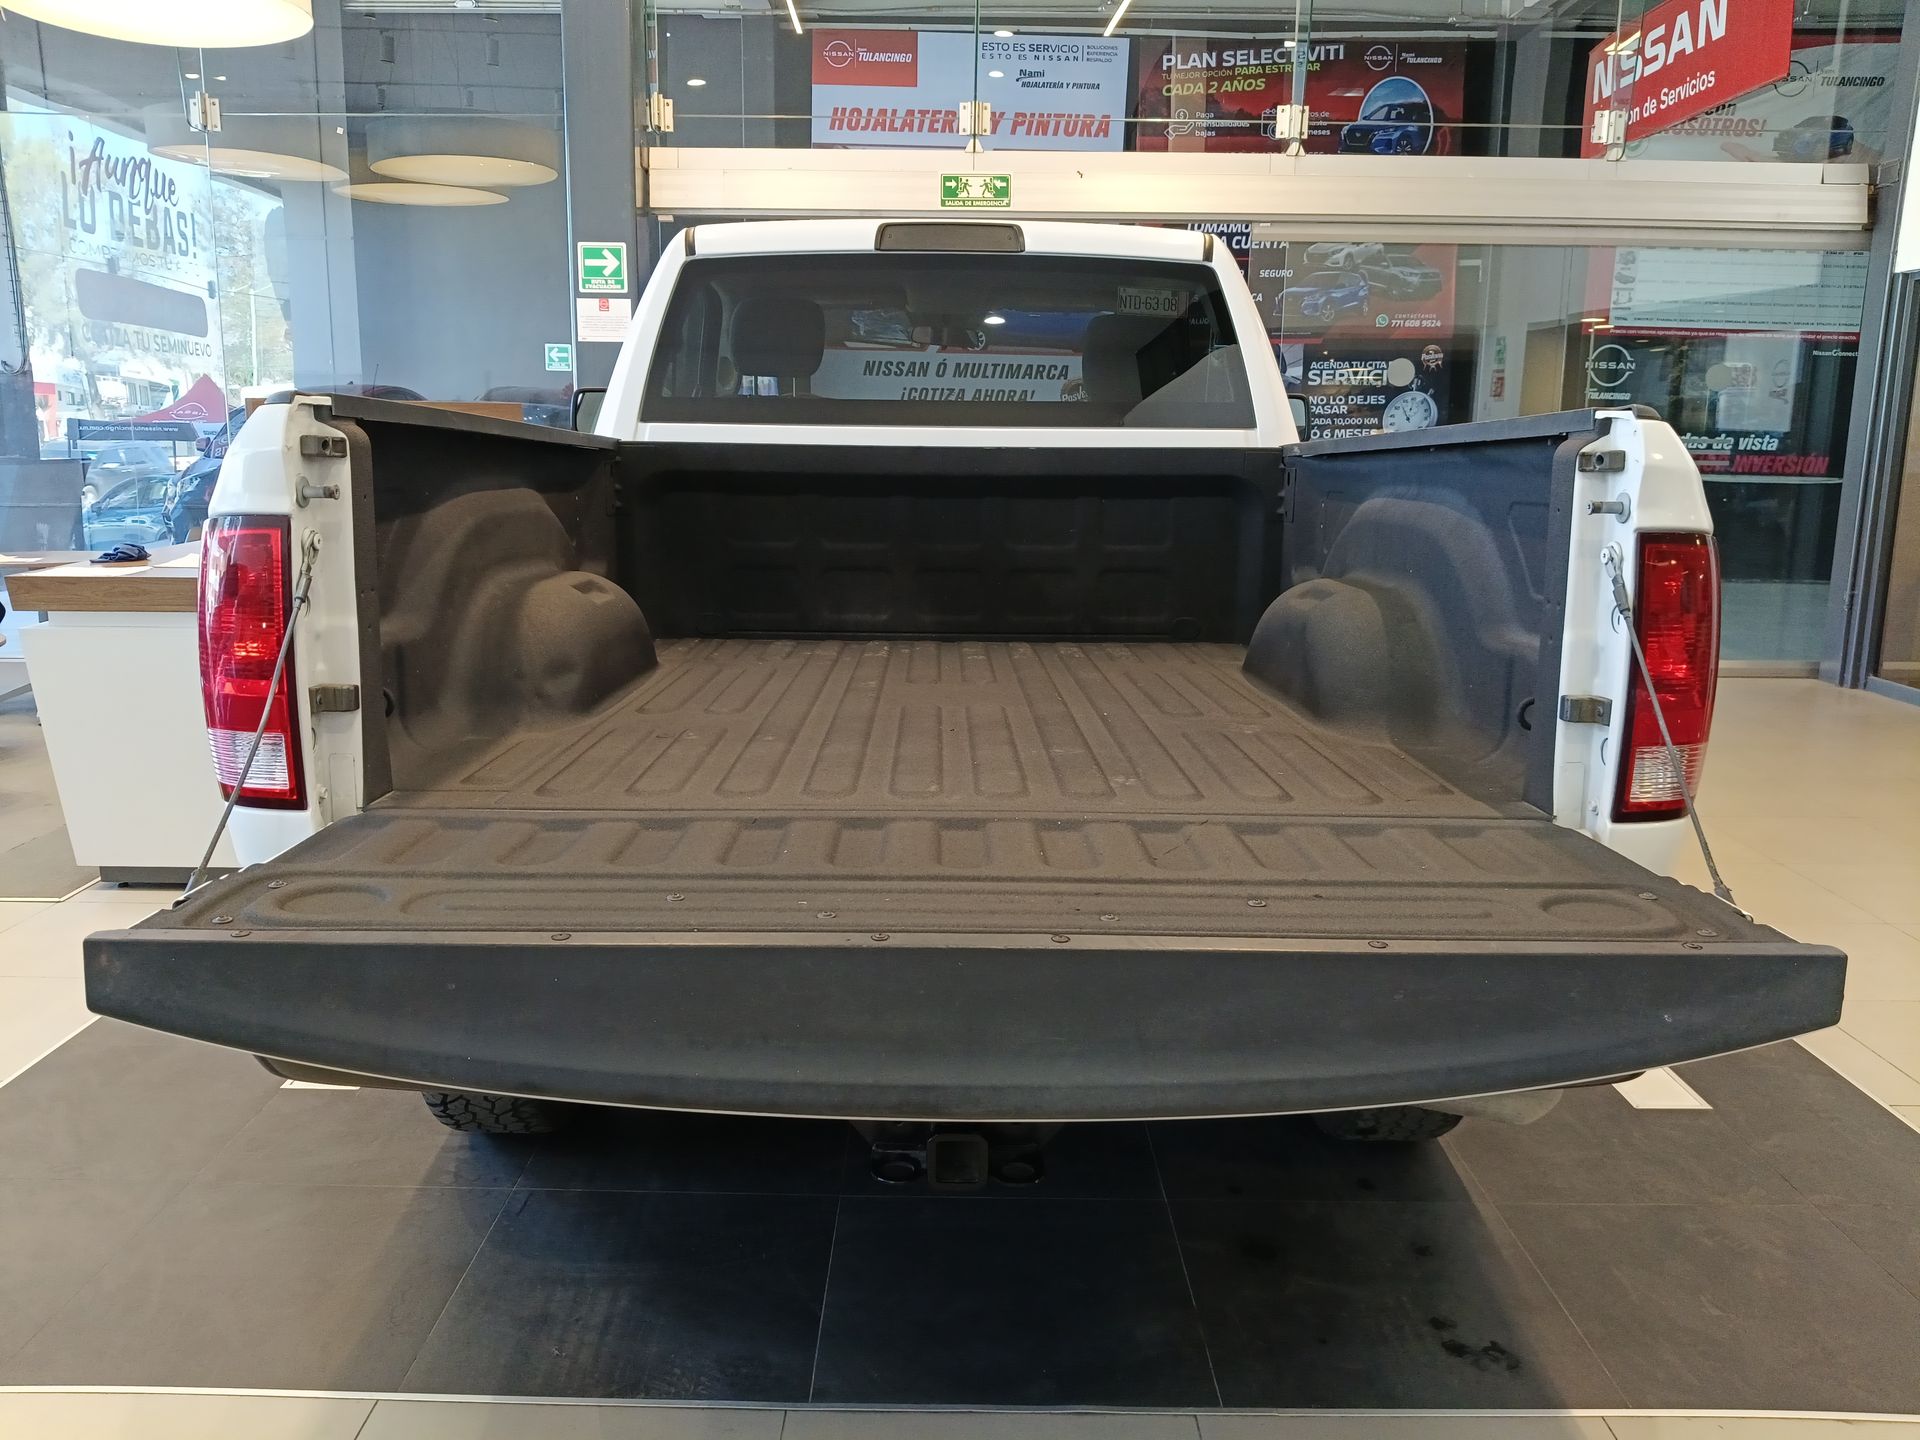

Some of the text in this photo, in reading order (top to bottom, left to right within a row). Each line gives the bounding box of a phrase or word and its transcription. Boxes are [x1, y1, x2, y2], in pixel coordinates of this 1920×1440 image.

[982, 42, 1079, 53] ESTO ES SERVICIO
[858, 52, 912, 63] TULANCINGO
[1033, 54, 1079, 62] NISSAN
[1162, 44, 1345, 70] PLAN SELECTVITI
[1019, 68, 1045, 78] Nami
[1174, 72, 1200, 80] MEJOR
[1202, 69, 1233, 78] OPCIÓN
[1235, 66, 1263, 75] PARA
[1265, 63, 1321, 74] ESTRAR
[1021, 80, 1064, 89] HOJALATERÍA
[1071, 82, 1100, 90] PINTURA
[1162, 76, 1266, 97] CADA 2 AÑOS
[1820, 76, 1886, 87] TULANCINGO
[1642, 96, 1657, 119] de
[1659, 70, 1716, 110] Servicios
[829, 107, 960, 134] HOJALATER
[1009, 111, 1111, 138] PINTURA
[1195, 129, 1216, 137] bajas
[108, 189, 197, 260] DEBAS!
[1187, 223, 1251, 233] TOMAMO
[1231, 235, 1290, 249] CUENTA
[1259, 269, 1294, 278] SEGURO
[1391, 320, 1404, 328] 771
[1421, 320, 1442, 328] 9524
[153, 334, 213, 358] SEMINUEVO
[863, 358, 1070, 381] NISSAN Ó MULTIMARCA
[1310, 361, 1387, 369] AGENDA TU CITA
[1585, 361, 1637, 370] NISSAN
[1307, 369, 1388, 386] SERVICI
[901, 386, 1036, 401] ¡COTIZA AHORA!
[1309, 395, 1386, 405] NO LO DEJES
[1310, 405, 1348, 415] PASAR
[1333, 417, 1363, 425] 10,000
[1364, 417, 1379, 425] KM
[1310, 426, 1320, 439] Ó
[1322, 428, 1331, 439] 6
[1738, 433, 1779, 451] vista
[1731, 453, 1830, 475] INVERSIÓN
